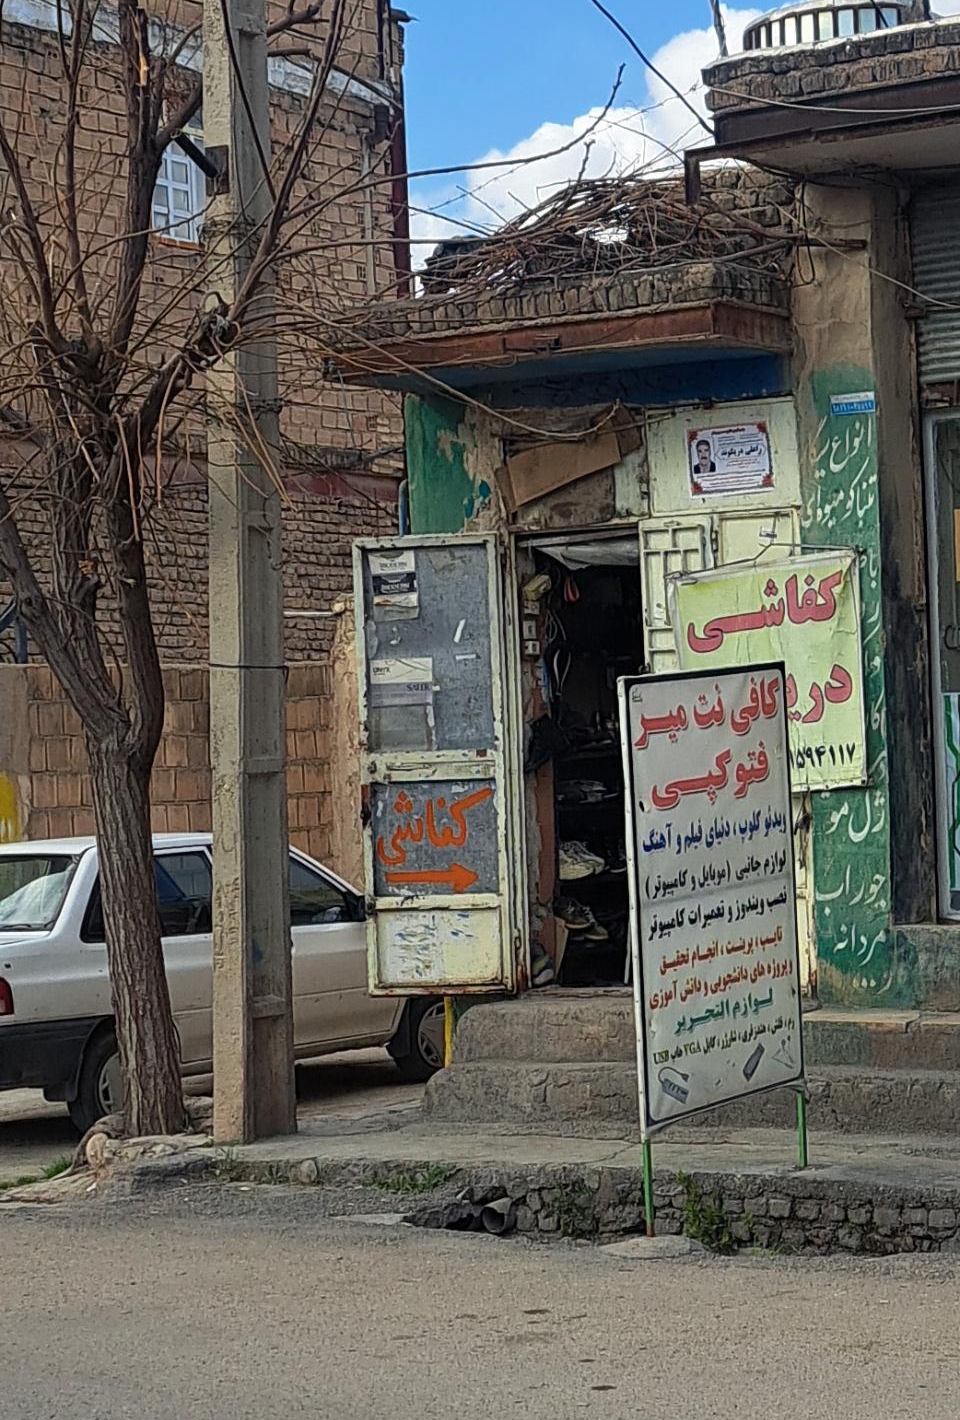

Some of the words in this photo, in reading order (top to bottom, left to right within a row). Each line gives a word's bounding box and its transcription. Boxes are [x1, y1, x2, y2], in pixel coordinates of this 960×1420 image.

[686, 569, 843, 653] کفاشی
[693, 682, 725, 729] نت
[730, 676, 779, 735] کافی
[633, 703, 689, 750] میر
[377, 786, 494, 866] کفاشی
[704, 815, 731, 850] دنیای
[825, 800, 850, 835] مو
[642, 823, 673, 854] آهنگ
[675, 834, 683, 856] و
[684, 817, 703, 854] فیلم
[734, 855, 762, 881] جانبی
[763, 848, 787, 874] لوازم
[690, 873, 696, 892] و
[815, 864, 887, 917] جوراب
[687, 899, 726, 930] تعمیرات
[727, 906, 733, 924] و
[734, 893, 766, 922] ویندوز
[766, 886, 788, 913] نصب
[648, 907, 686, 941] کامپیوتر
[691, 939, 719, 969] انجام
[832, 923, 888, 966] مردانه
[659, 947, 690, 976] تحقیق
[749, 963, 766, 985] های
[649, 980, 678, 1011] آموزی
[680, 980, 702, 1003] دانش
[703, 983, 709, 997] و
[732, 986, 774, 1020] لوازم
[674, 998, 730, 1036] التحریر
